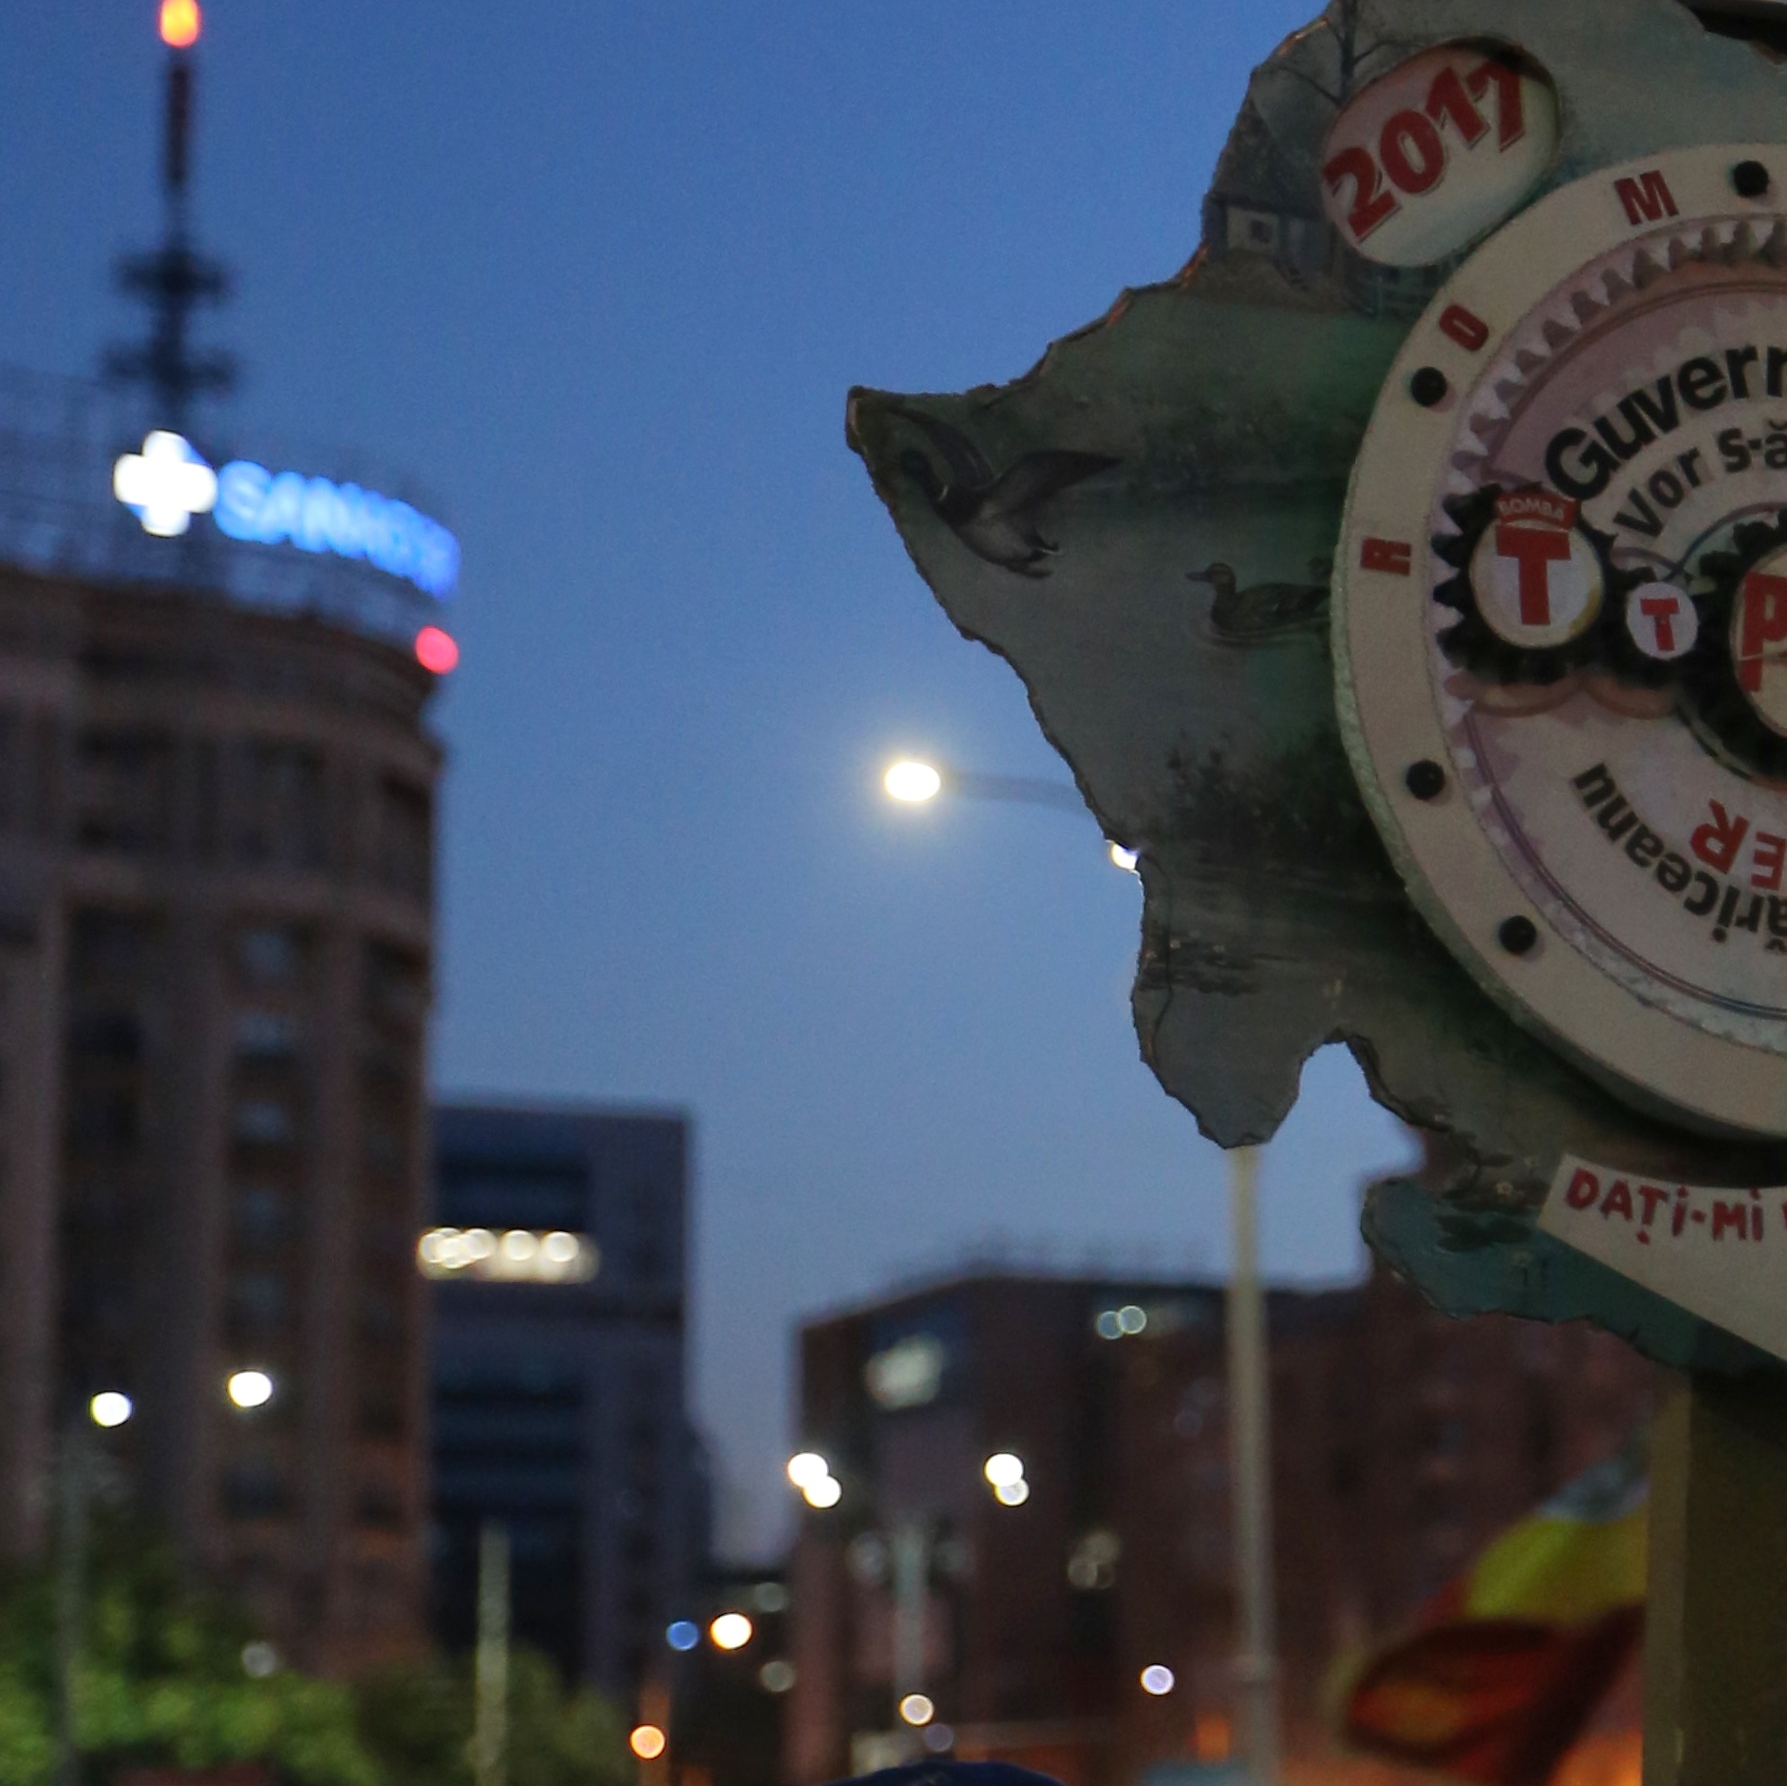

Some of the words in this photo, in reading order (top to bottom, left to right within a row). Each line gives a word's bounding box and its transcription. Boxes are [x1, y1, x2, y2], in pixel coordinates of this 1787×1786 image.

[1323, 62, 1525, 242] 2017
[1614, 447, 1700, 539] vor
[1495, 525, 1571, 625] T
[1640, 598, 1679, 651] T
